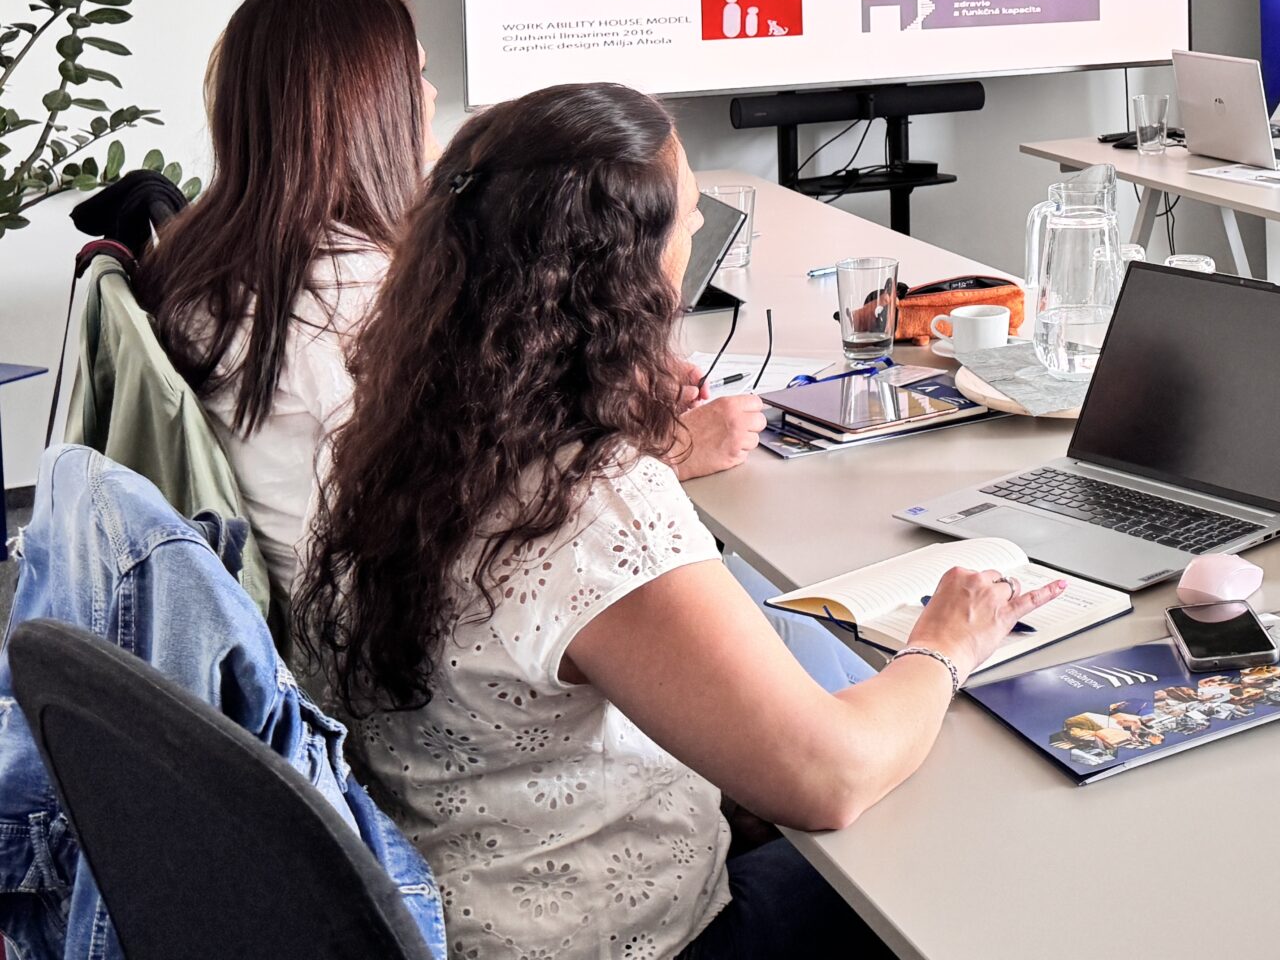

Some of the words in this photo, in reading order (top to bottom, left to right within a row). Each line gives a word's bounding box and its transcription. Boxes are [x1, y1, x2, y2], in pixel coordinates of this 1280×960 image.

[953, 0, 991, 9] zdravie
[1001, 6, 1042, 16] kapacita
[502, 22, 544, 32] WORK
[546, 19, 596, 30] ABILITY
[598, 18, 643, 28] HOUSE
[646, 15, 692, 25] MODEL
[622, 28, 654, 37] 2016
[502, 43, 554, 54] Graphic
[556, 41, 600, 51] design
